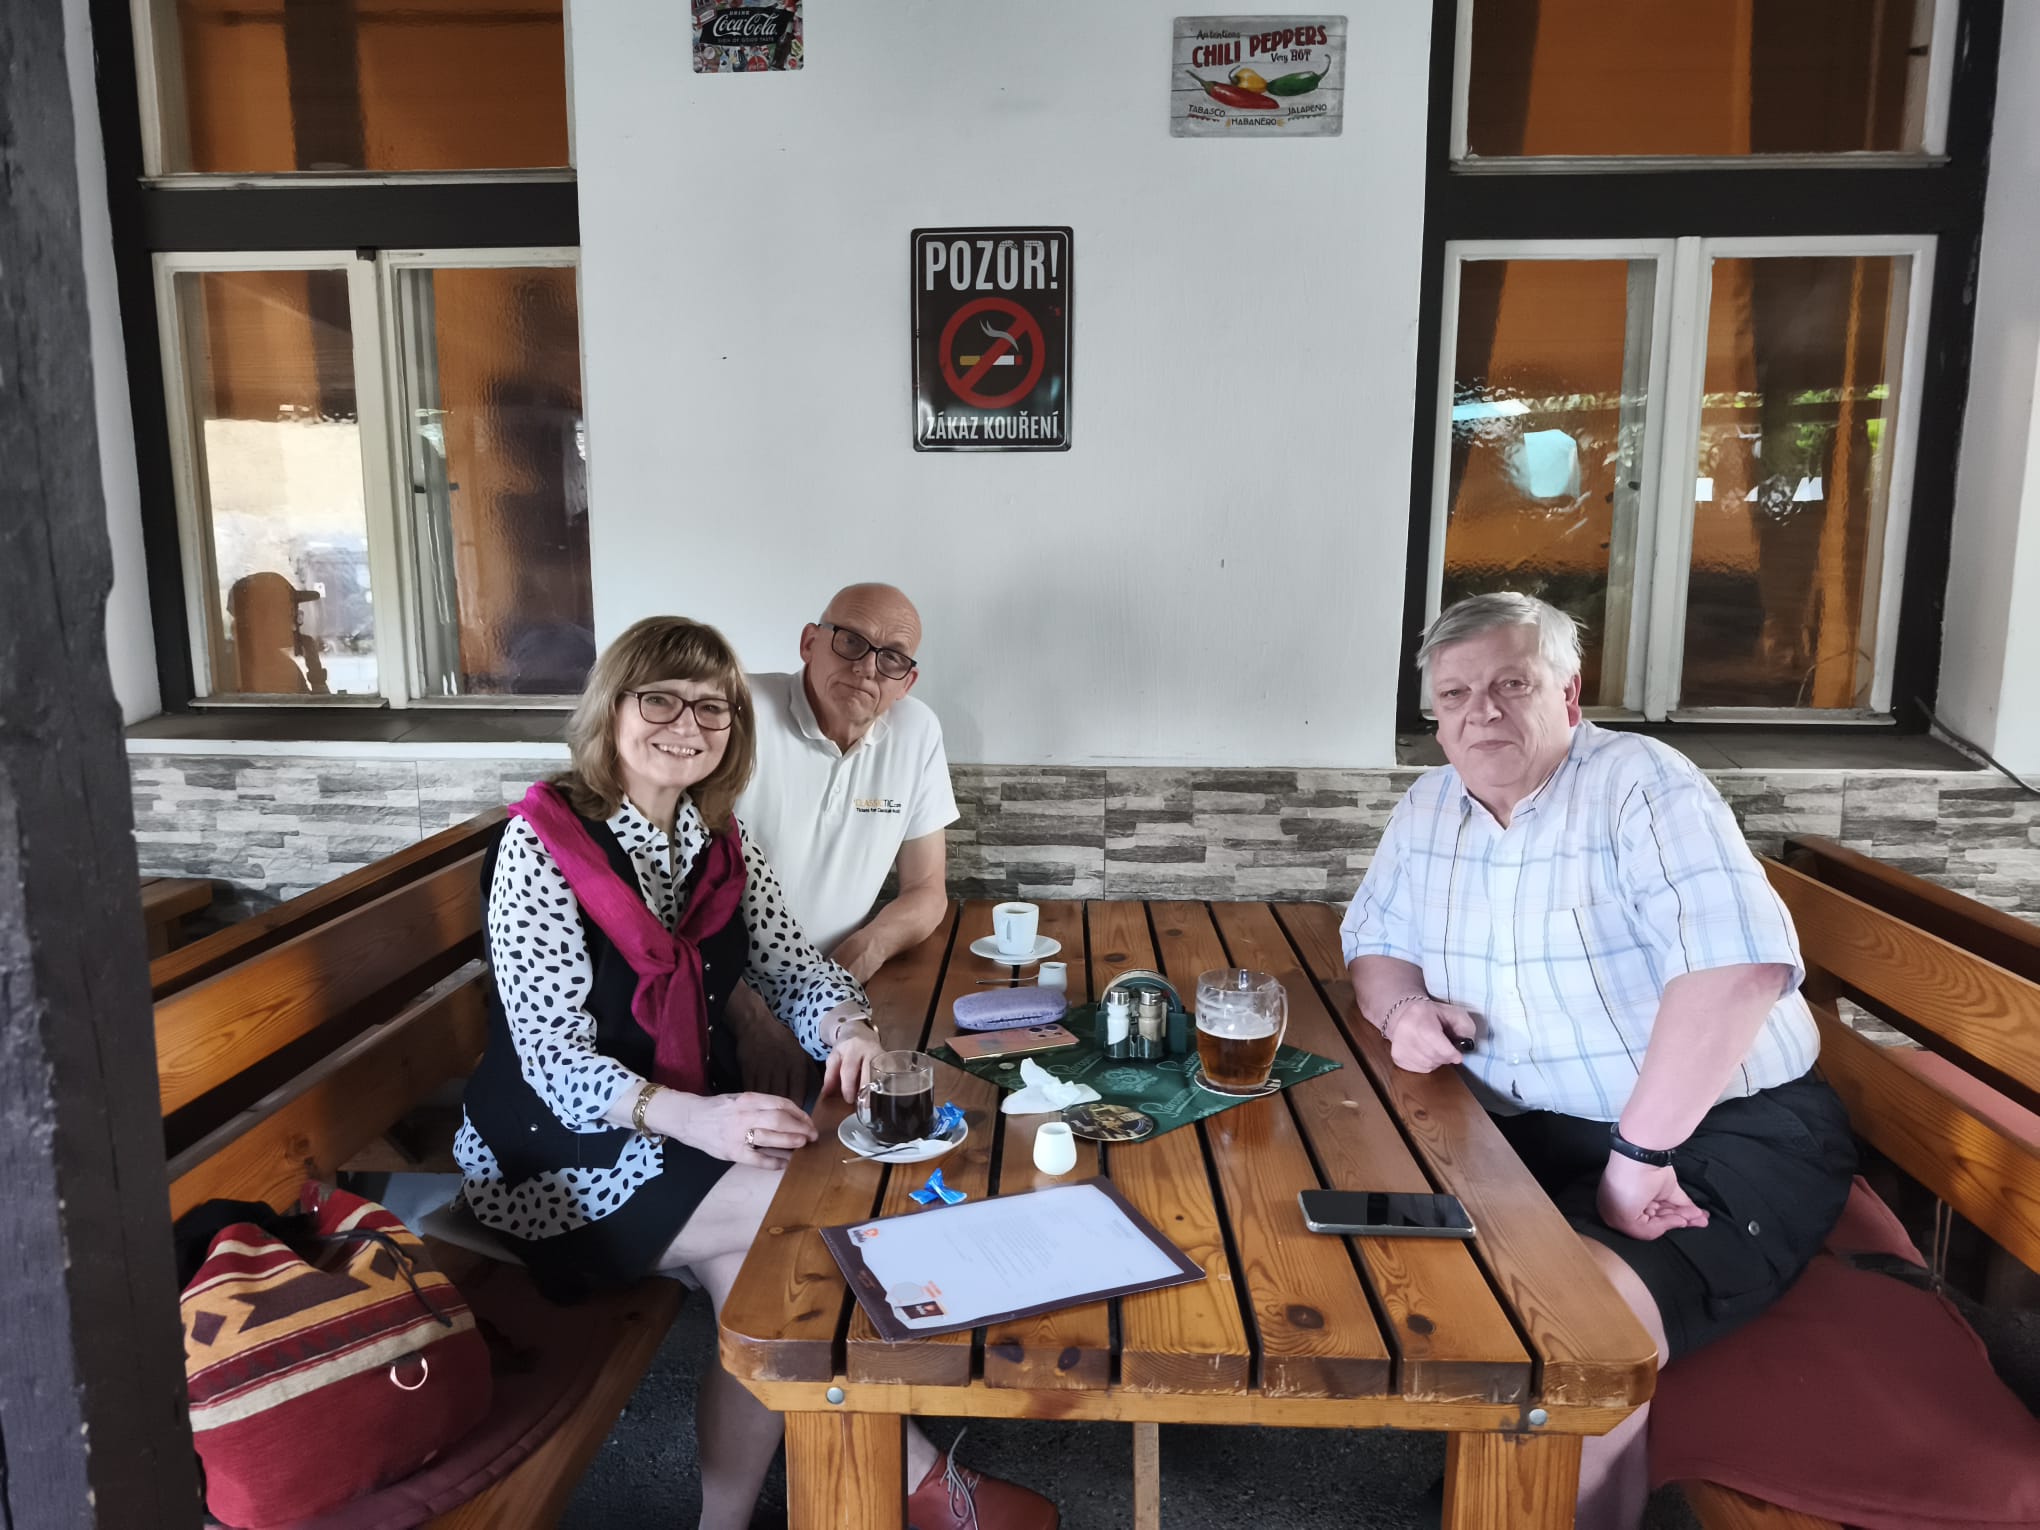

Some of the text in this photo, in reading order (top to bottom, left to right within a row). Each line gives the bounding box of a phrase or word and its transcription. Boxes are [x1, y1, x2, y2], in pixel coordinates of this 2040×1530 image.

[1192, 25, 1328, 68] CHILI PEPPERS
[1271, 49, 1312, 64] Very HOT
[1188, 104, 1226, 118] TABASCO
[1231, 117, 1277, 127] HABANERO
[925, 239, 1059, 291] POZOR!
[926, 410, 1059, 440] ZÁKAZ KOUŘENÍ
